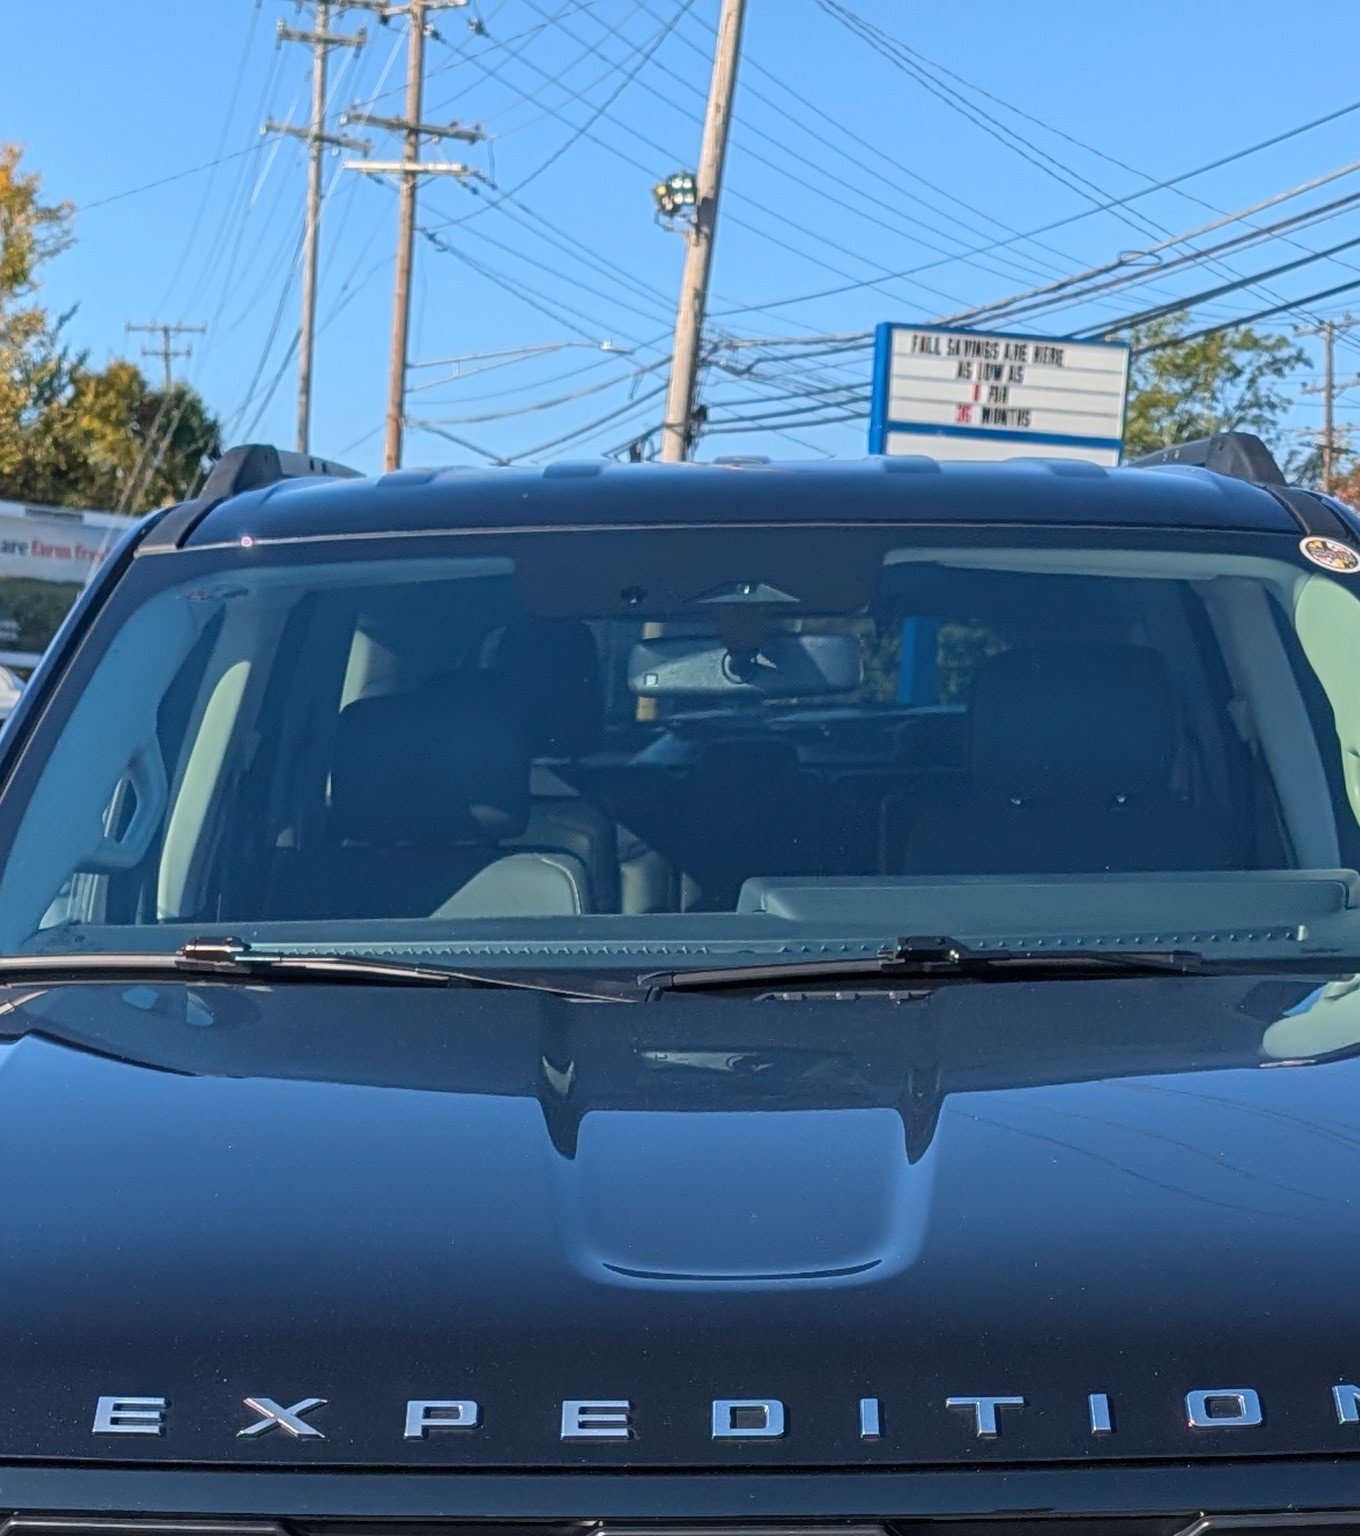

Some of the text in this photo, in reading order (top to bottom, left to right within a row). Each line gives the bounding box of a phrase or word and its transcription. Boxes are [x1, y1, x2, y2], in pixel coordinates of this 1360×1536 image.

[911, 335, 1064, 367] FALL SAVINGS ARE HERE
[956, 360, 1025, 383] AS LOW AS
[989, 385, 1009, 403] FOR
[981, 406, 1031, 427] MONTHS
